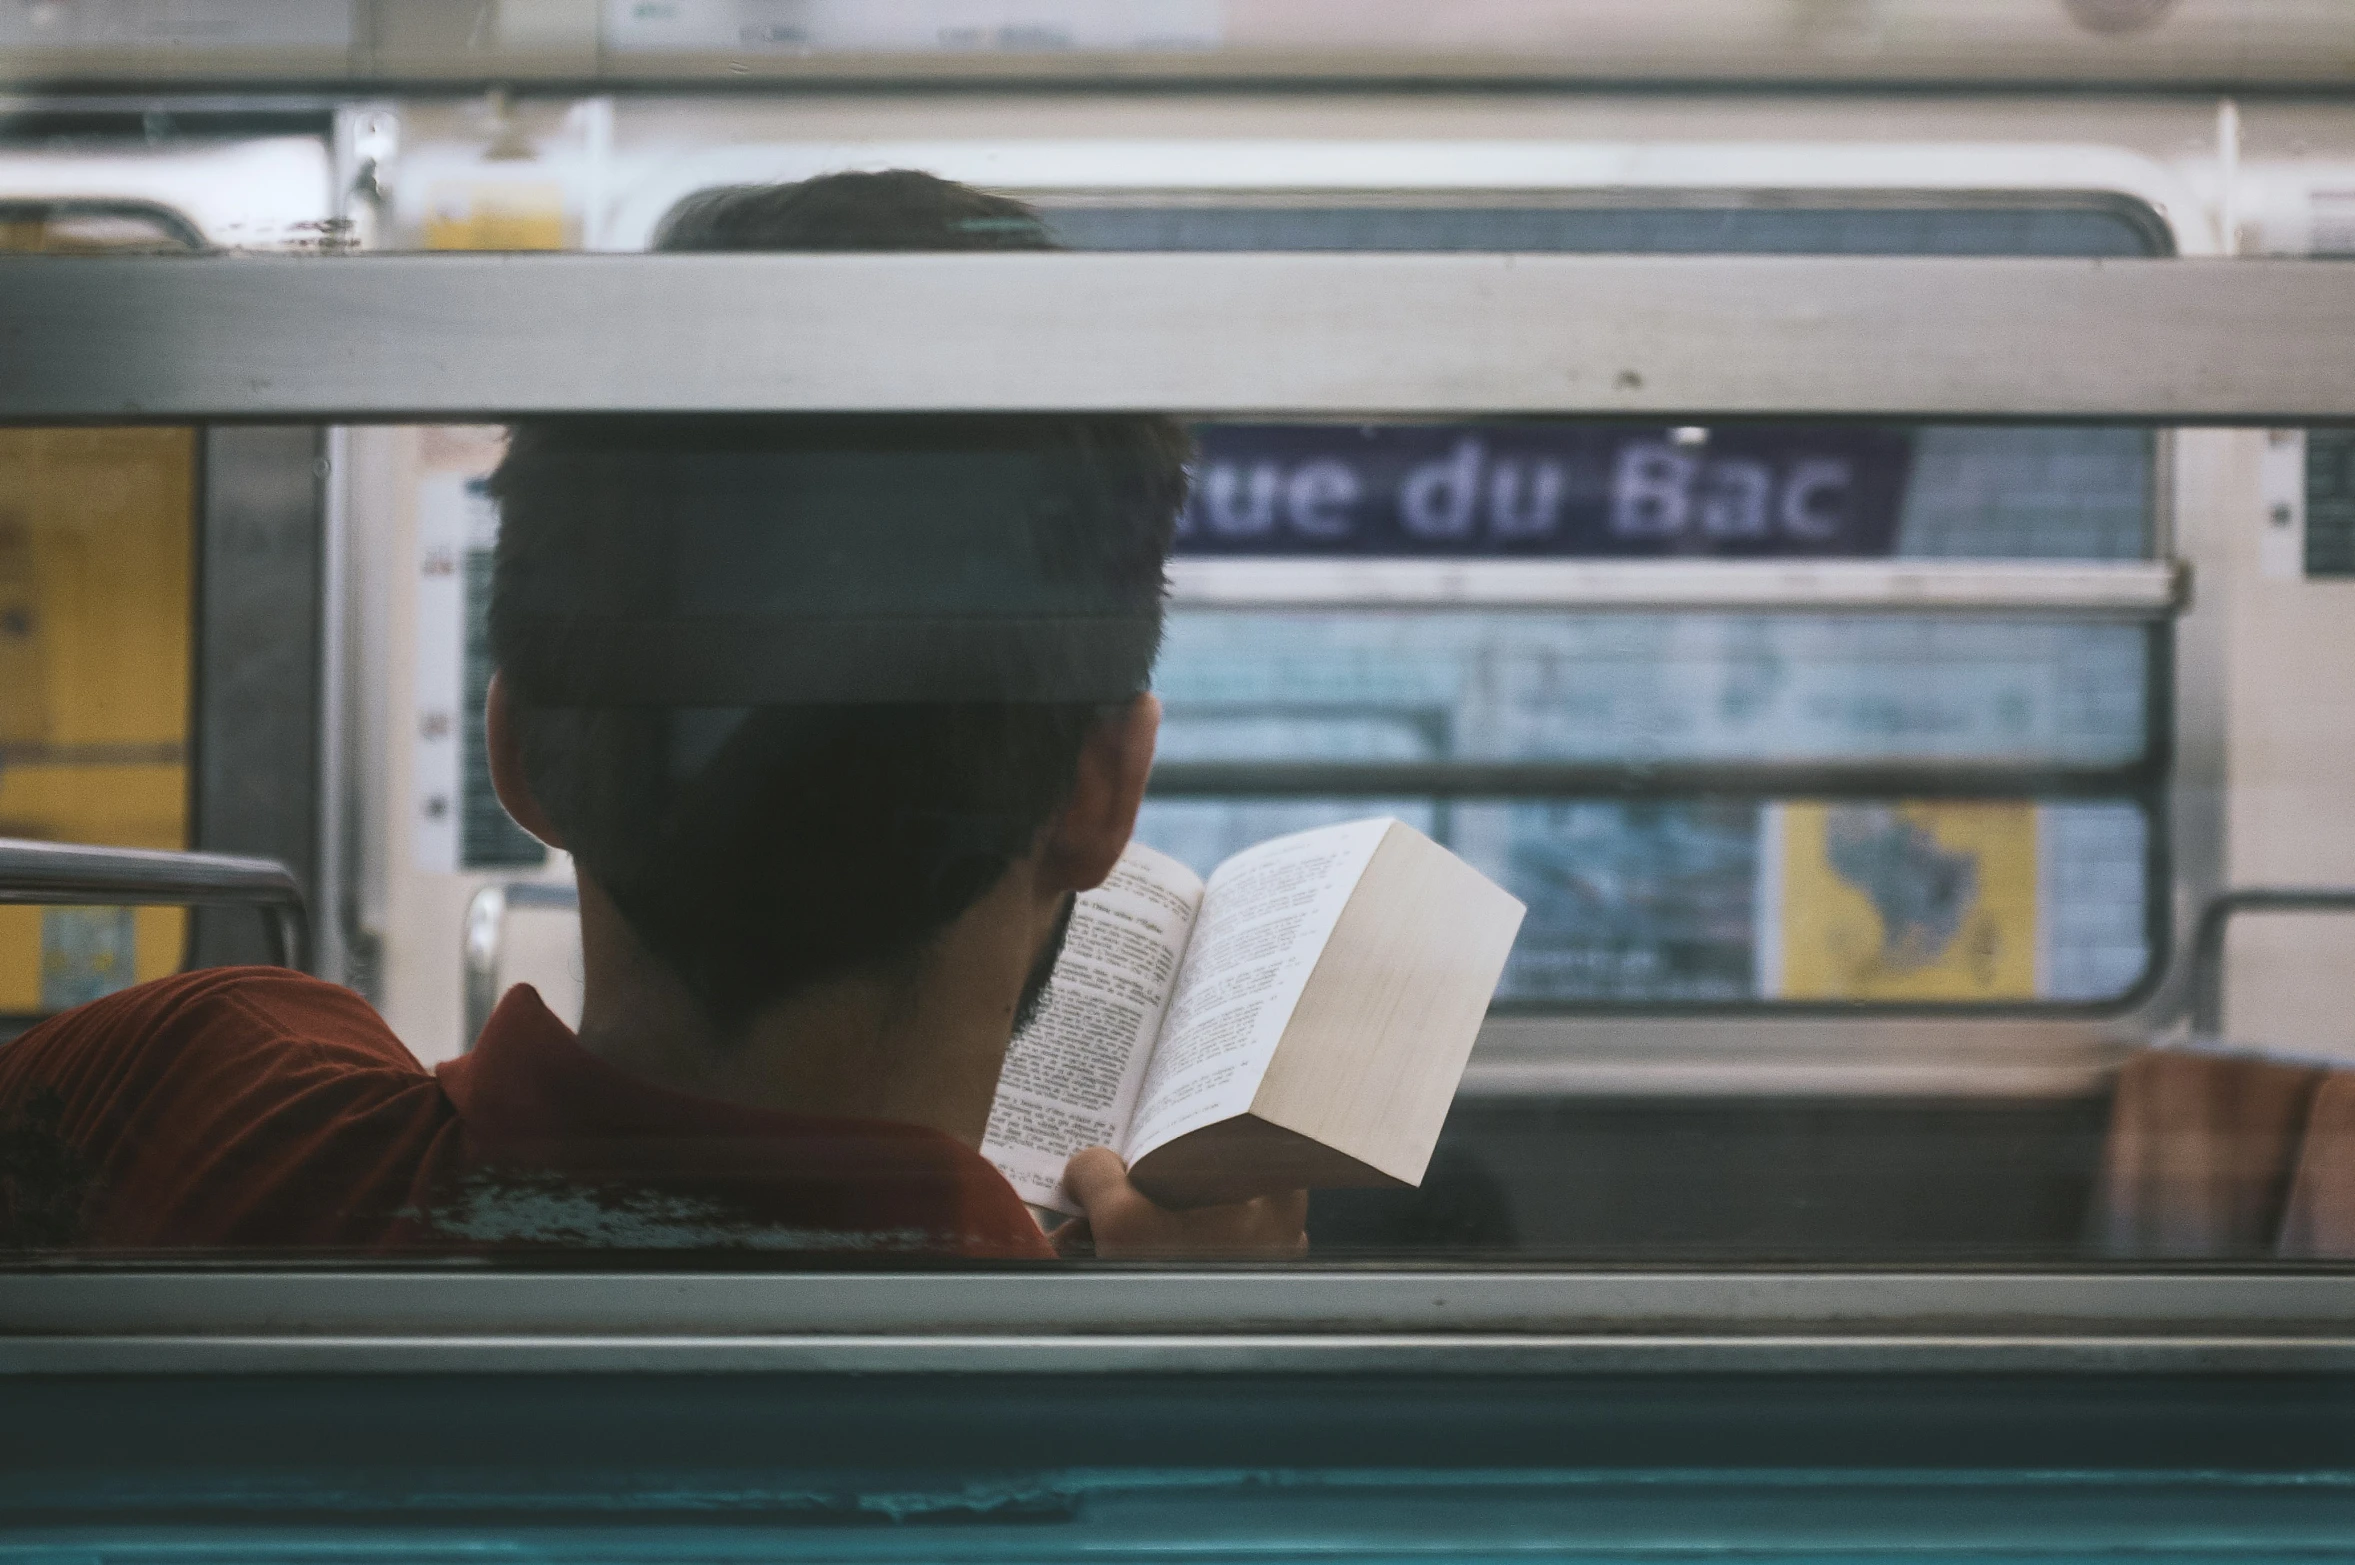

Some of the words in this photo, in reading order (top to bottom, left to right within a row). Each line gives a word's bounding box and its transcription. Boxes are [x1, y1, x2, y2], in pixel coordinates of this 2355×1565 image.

[1175, 455, 1360, 537] ue
[1402, 440, 1563, 537] du
[1609, 443, 1851, 537] Bac
